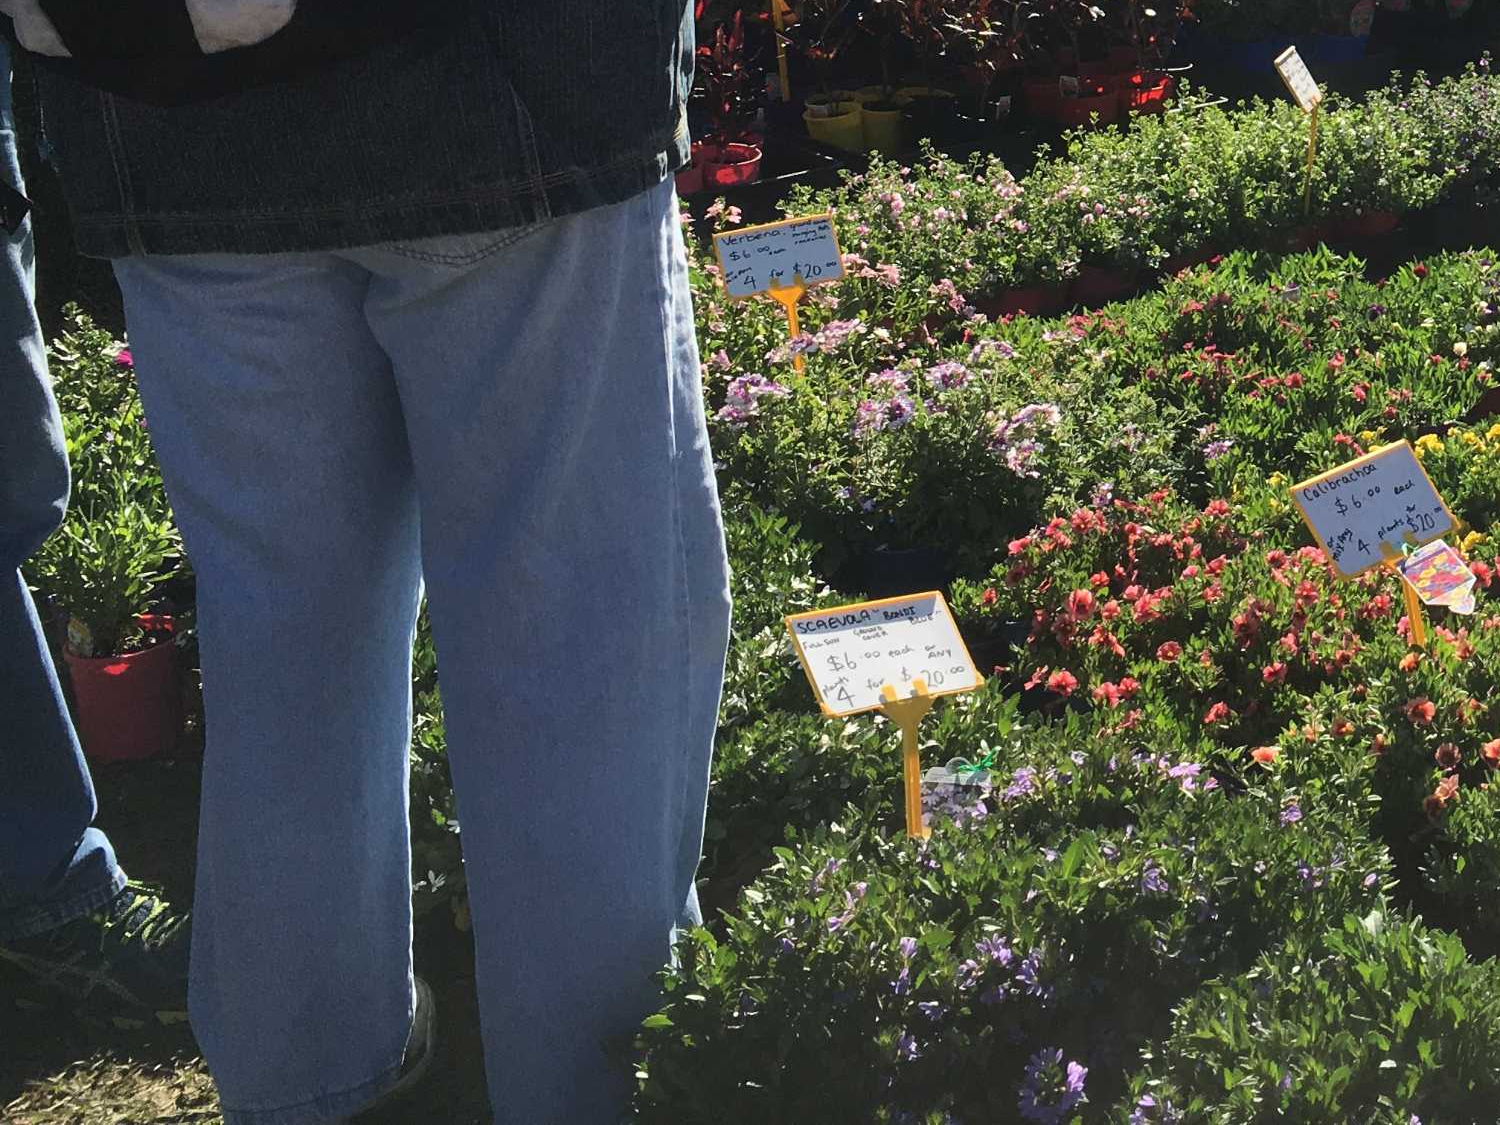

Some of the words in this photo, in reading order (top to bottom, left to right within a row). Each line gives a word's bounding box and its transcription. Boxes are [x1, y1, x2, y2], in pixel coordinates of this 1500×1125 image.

[743, 275, 756, 290] 4
[769, 268, 784, 278] for
[1303, 463, 1377, 501] Calibrachoa
[1394, 479, 1415, 495] each
[1358, 538, 1371, 556] 4
[1378, 518, 1405, 540] plants
[797, 609, 872, 635] SCAEVOLA
[888, 645, 915, 657] each
[928, 649, 952, 660] ANY
[837, 686, 857, 708] 4
[866, 678, 885, 690] for
